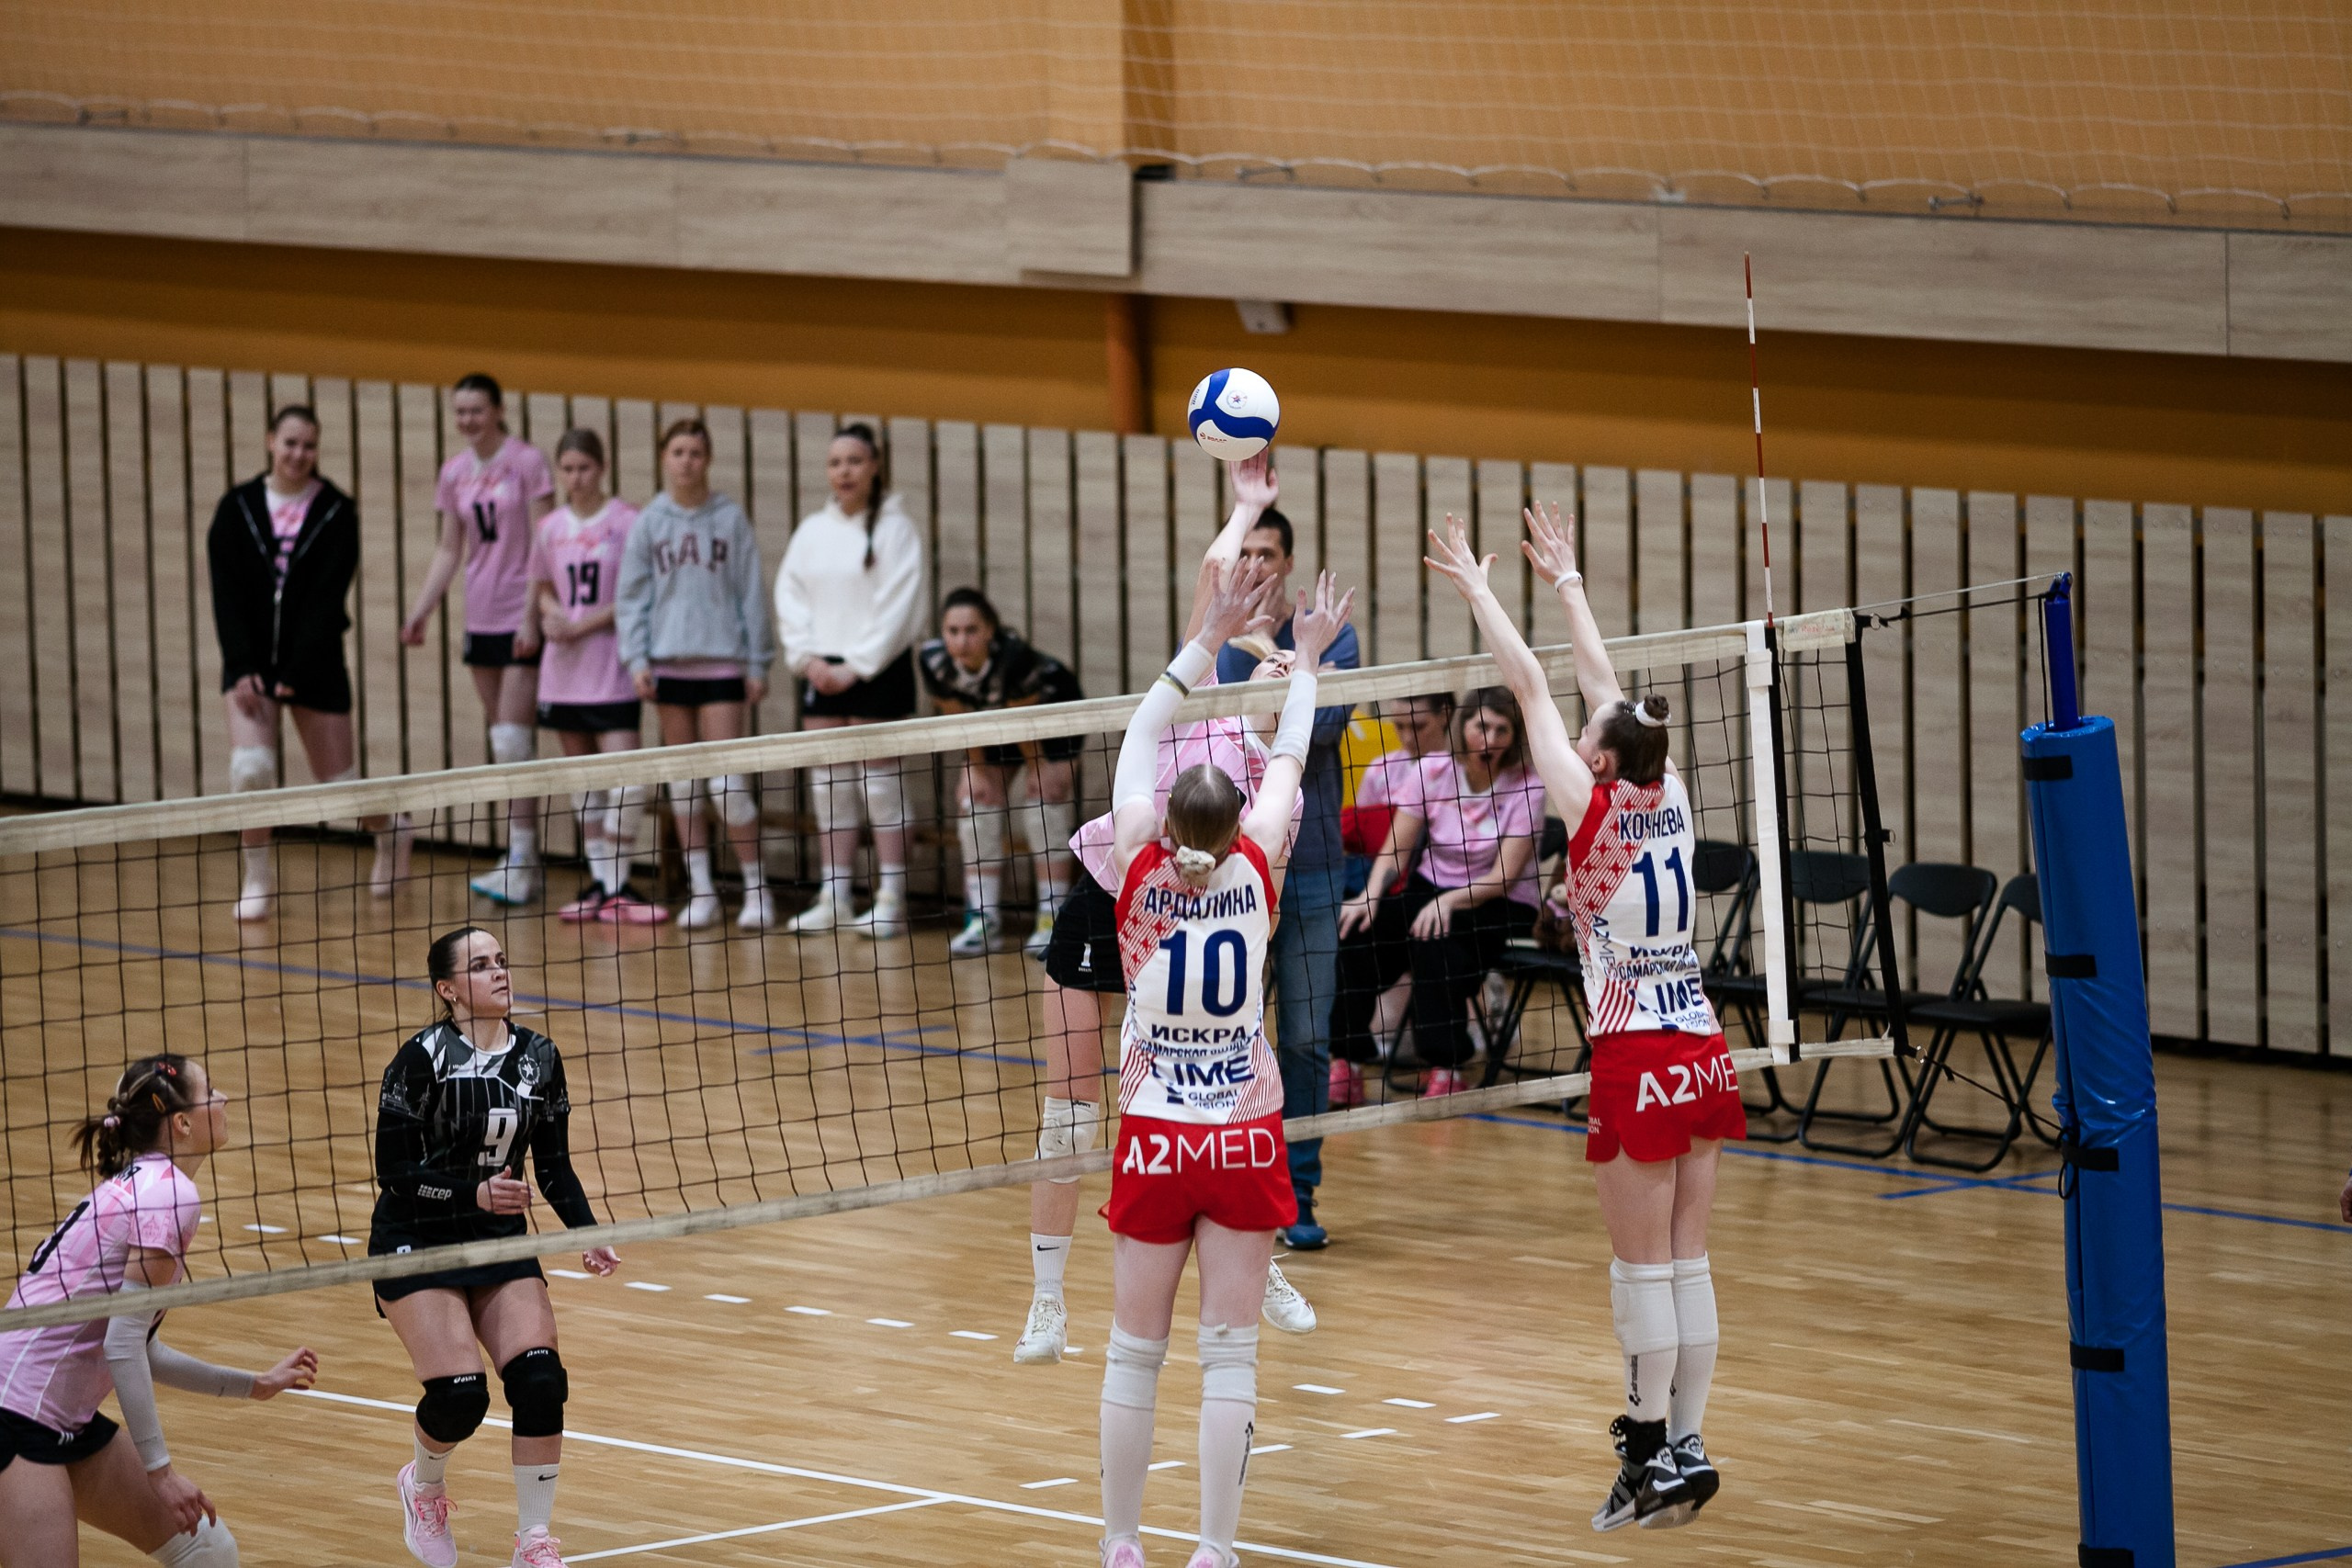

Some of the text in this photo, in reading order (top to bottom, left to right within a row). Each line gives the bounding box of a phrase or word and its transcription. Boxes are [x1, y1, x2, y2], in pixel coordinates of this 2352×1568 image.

[652, 533, 729, 575] GAP
[565, 561, 601, 607] 19
[1618, 805, 1686, 841] КОЧНЕВА
[1144, 884, 1257, 920] АРДАЛИНА
[1632, 847, 1689, 938] 11
[1159, 929, 1248, 1017] 10
[1150, 1023, 1246, 1043] ИСКРА
[1675, 1010, 1710, 1024] GLOBA
[477, 1107, 518, 1167] 9
[1122, 1127, 1276, 1175] A2MED
